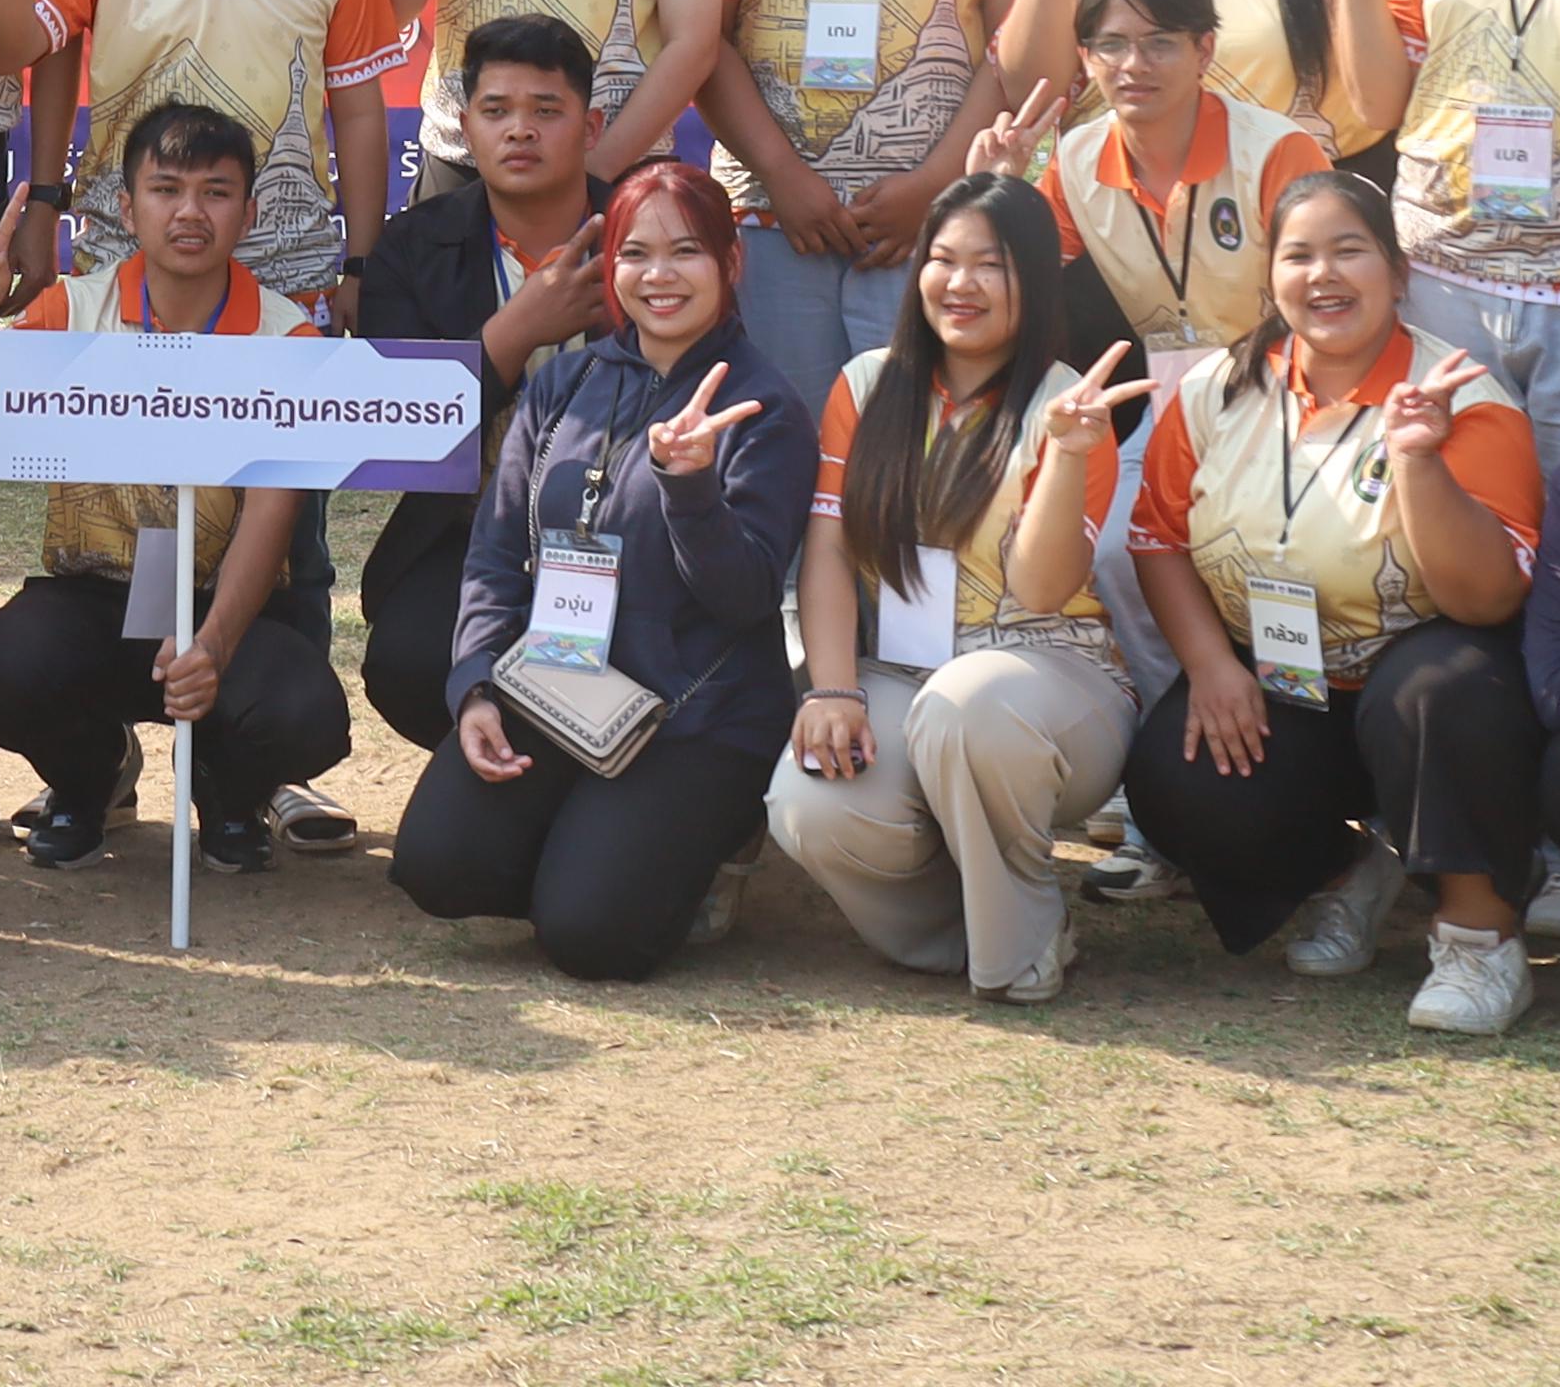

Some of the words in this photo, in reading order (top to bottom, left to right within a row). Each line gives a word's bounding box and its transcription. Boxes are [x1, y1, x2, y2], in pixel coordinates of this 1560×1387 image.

[827, 26, 857, 38] เกม
[4, 385, 465, 428] มหาวิทยาลัยราชภัฏนครสวรรค์
[554, 594, 593, 617] องุ่น
[1264, 623, 1309, 646] กล้วย
